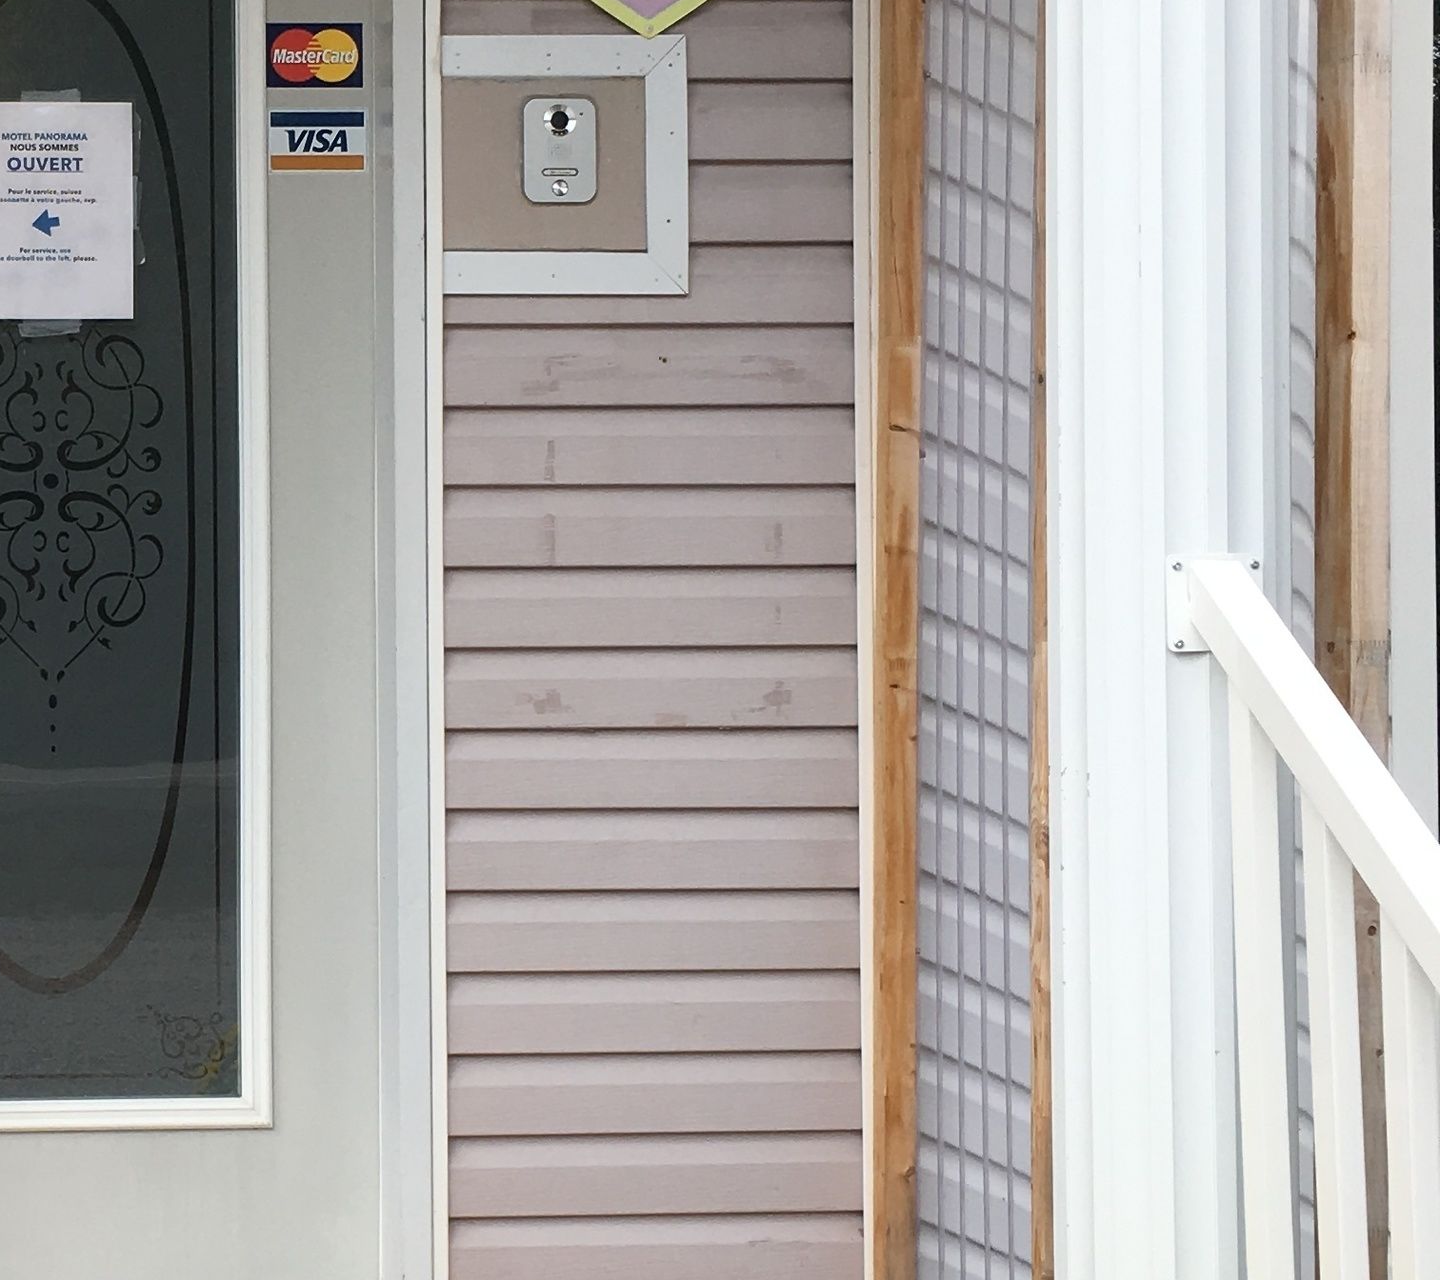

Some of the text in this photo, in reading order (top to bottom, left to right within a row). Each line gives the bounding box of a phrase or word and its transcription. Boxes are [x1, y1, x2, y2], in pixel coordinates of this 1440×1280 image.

[272, 48, 357, 64] MasterCard
[1, 133, 88, 141] MOTEL PANORAMA
[285, 129, 349, 153] VISA
[7, 157, 83, 171] OUVERT
